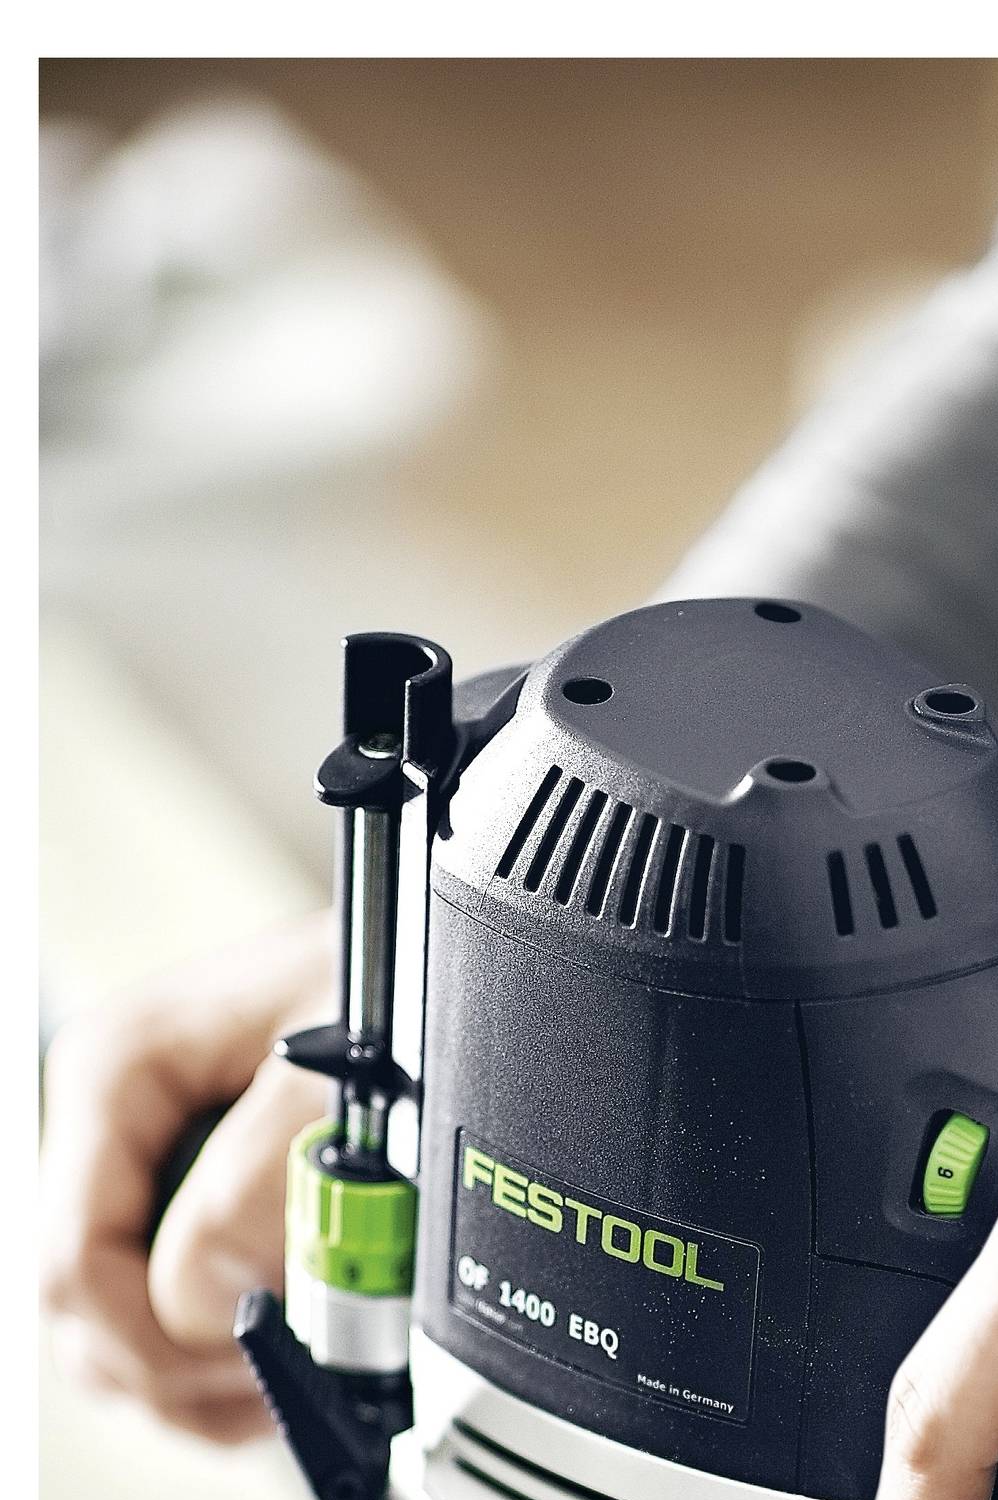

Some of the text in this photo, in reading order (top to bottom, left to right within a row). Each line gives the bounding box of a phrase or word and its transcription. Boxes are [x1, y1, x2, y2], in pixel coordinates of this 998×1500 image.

[464, 1147, 724, 1291] FESTOOL
[500, 1281, 556, 1327] 1400
[569, 1313, 619, 1359] EBQ
[637, 1374, 734, 1413] Made in Germany
